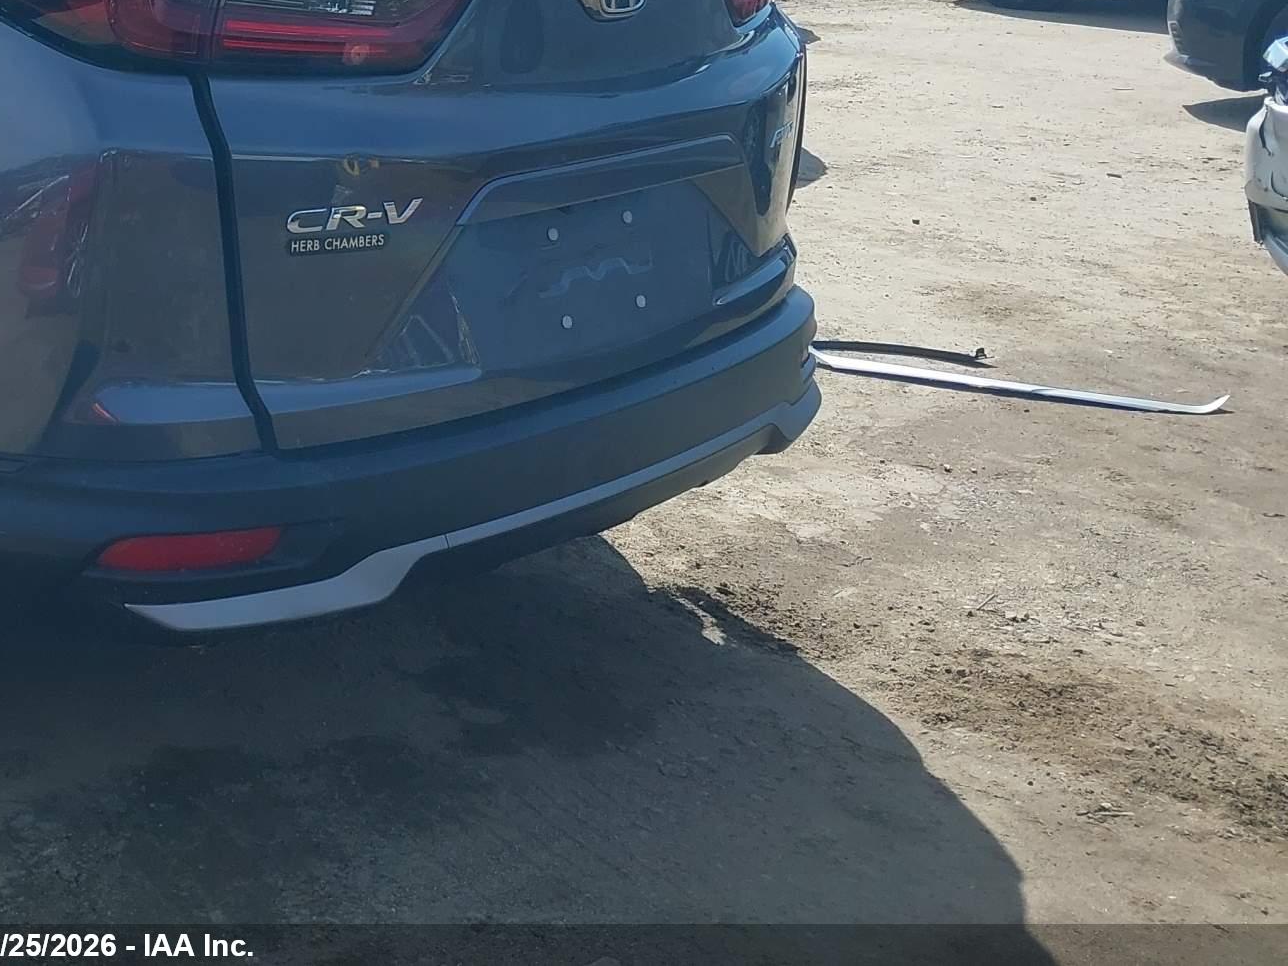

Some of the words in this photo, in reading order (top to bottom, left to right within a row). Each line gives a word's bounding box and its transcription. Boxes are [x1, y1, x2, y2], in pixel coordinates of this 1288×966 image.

[287, 197, 424, 234] CR-V
[291, 240, 320, 253] HERB
[324, 234, 385, 251] CHAMBERS
